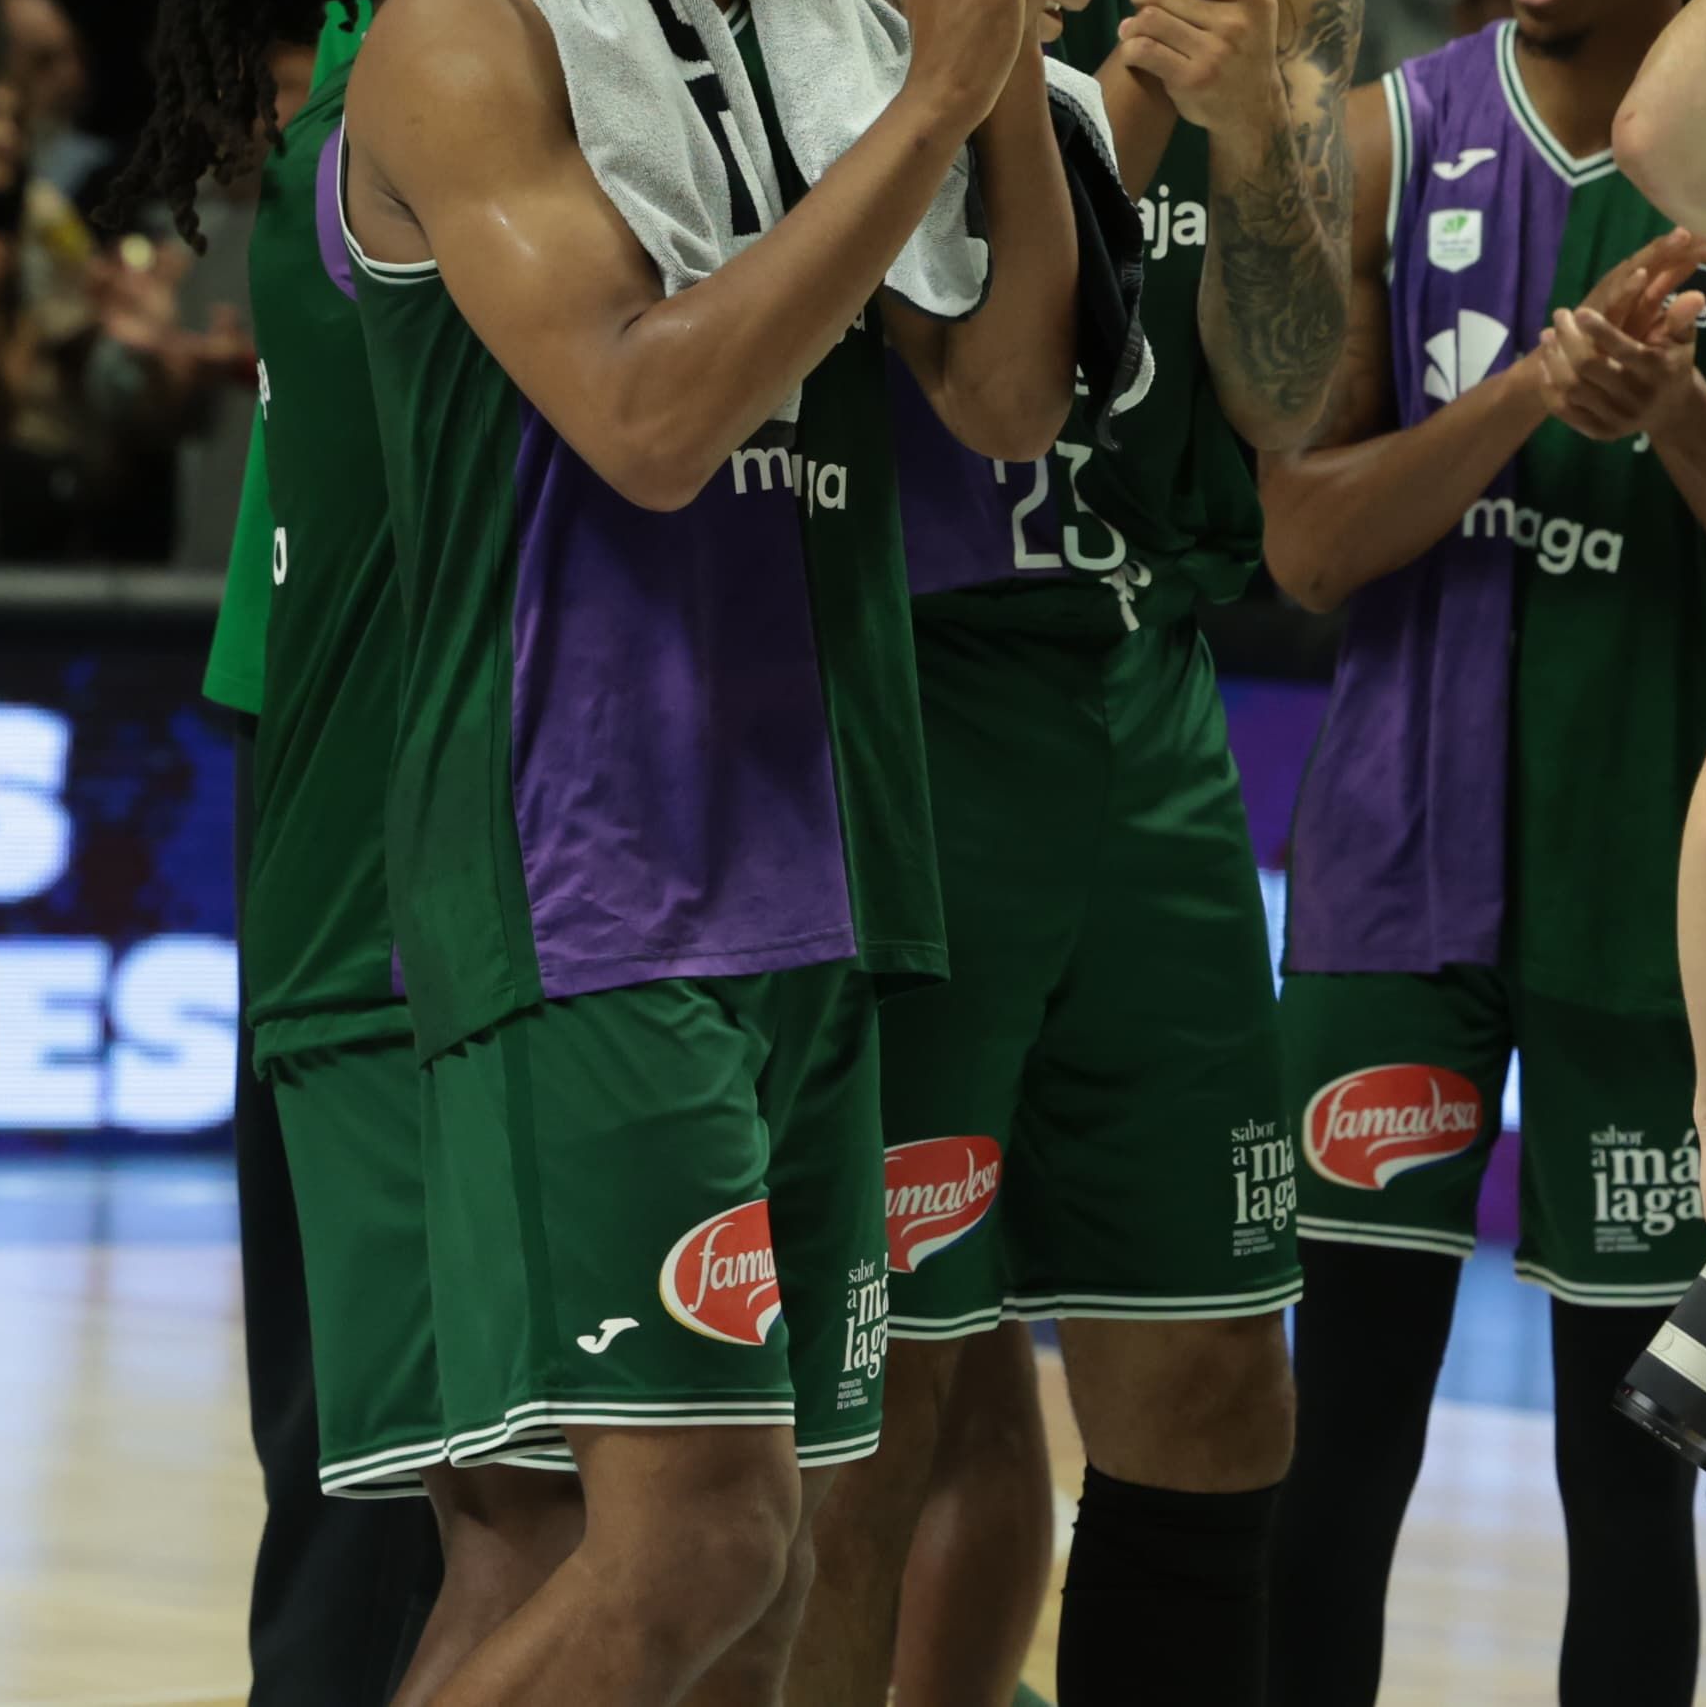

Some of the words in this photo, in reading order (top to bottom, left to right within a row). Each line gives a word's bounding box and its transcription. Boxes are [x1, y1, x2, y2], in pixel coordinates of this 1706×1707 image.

[994, 440, 1127, 573] 23
[1231, 1118, 1276, 1142] sabor
[1315, 1076, 1478, 1159] famadesa
[1590, 1123, 1645, 1146] sabor
[885, 1147, 999, 1220] madesa
[1233, 1146, 1247, 1166] a
[1610, 1127, 1700, 1185] má
[1232, 1171, 1297, 1231] laga
[1593, 1171, 1704, 1236] laga
[846, 1288, 858, 1310] a
[847, 1258, 876, 1285] sabor
